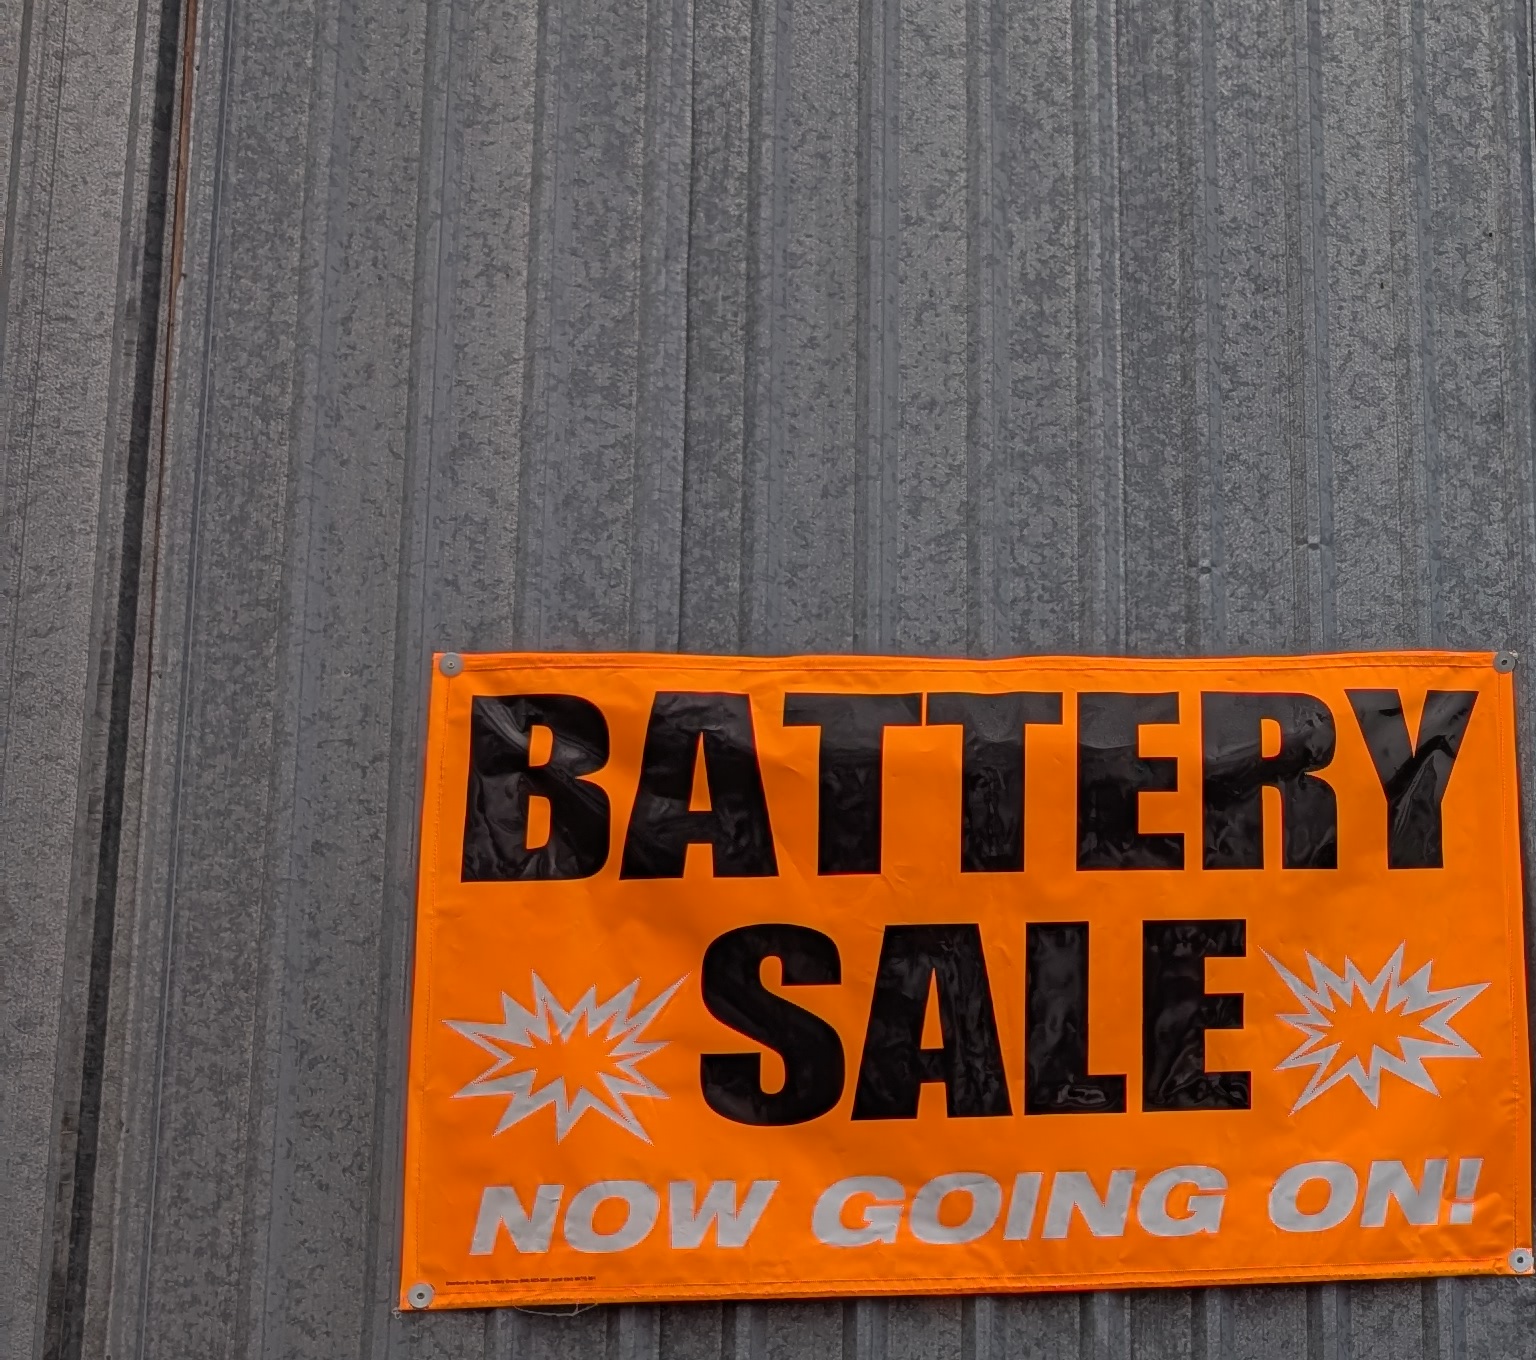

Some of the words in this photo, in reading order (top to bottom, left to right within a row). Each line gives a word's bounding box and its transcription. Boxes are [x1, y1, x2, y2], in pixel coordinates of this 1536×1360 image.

[461, 689, 1478, 883] BATTERY
[700, 919, 1252, 1127] SALE
[469, 1179, 780, 1256] NOW
[811, 1165, 1228, 1246] GOING
[1267, 1157, 1484, 1234] ON!
